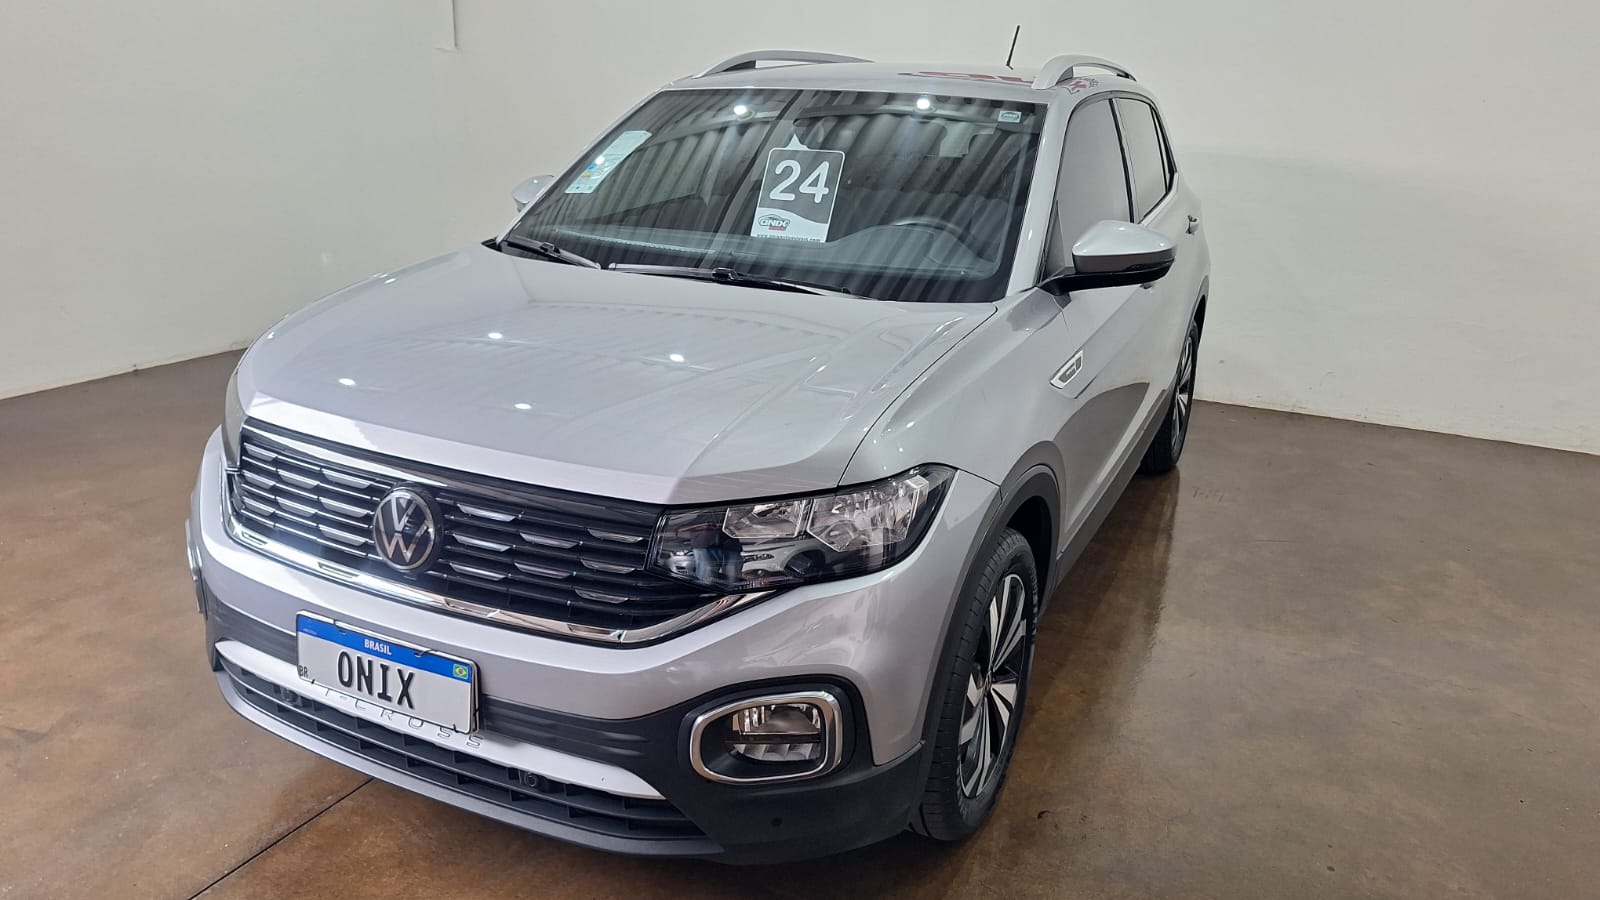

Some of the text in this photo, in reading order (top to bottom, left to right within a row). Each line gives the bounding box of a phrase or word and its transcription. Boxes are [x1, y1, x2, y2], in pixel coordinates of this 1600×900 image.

[769, 160, 829, 204] 24
[760, 219, 789, 228] ONIX
[364, 639, 393, 656] BRASIL
[337, 651, 415, 710] ONIX
